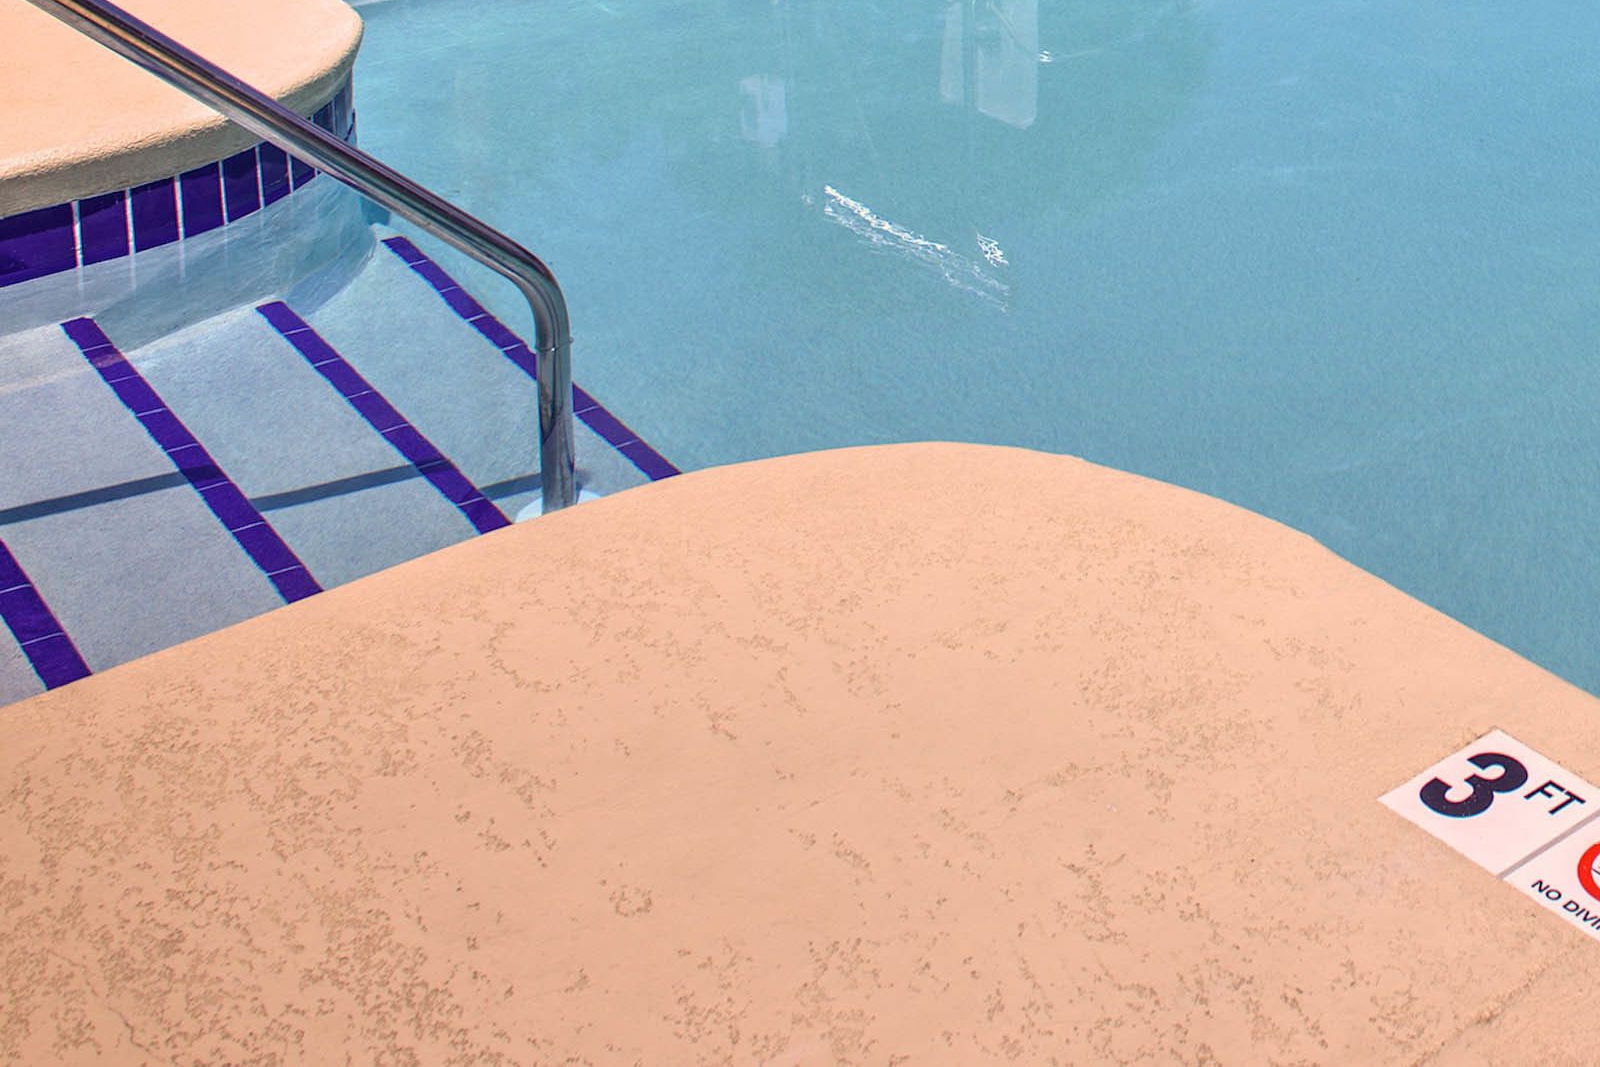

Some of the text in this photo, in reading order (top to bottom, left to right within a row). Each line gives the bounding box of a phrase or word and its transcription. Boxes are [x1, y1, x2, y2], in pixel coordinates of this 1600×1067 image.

[1419, 751, 1587, 819] 3 FT
[1530, 878, 1563, 903] NO
